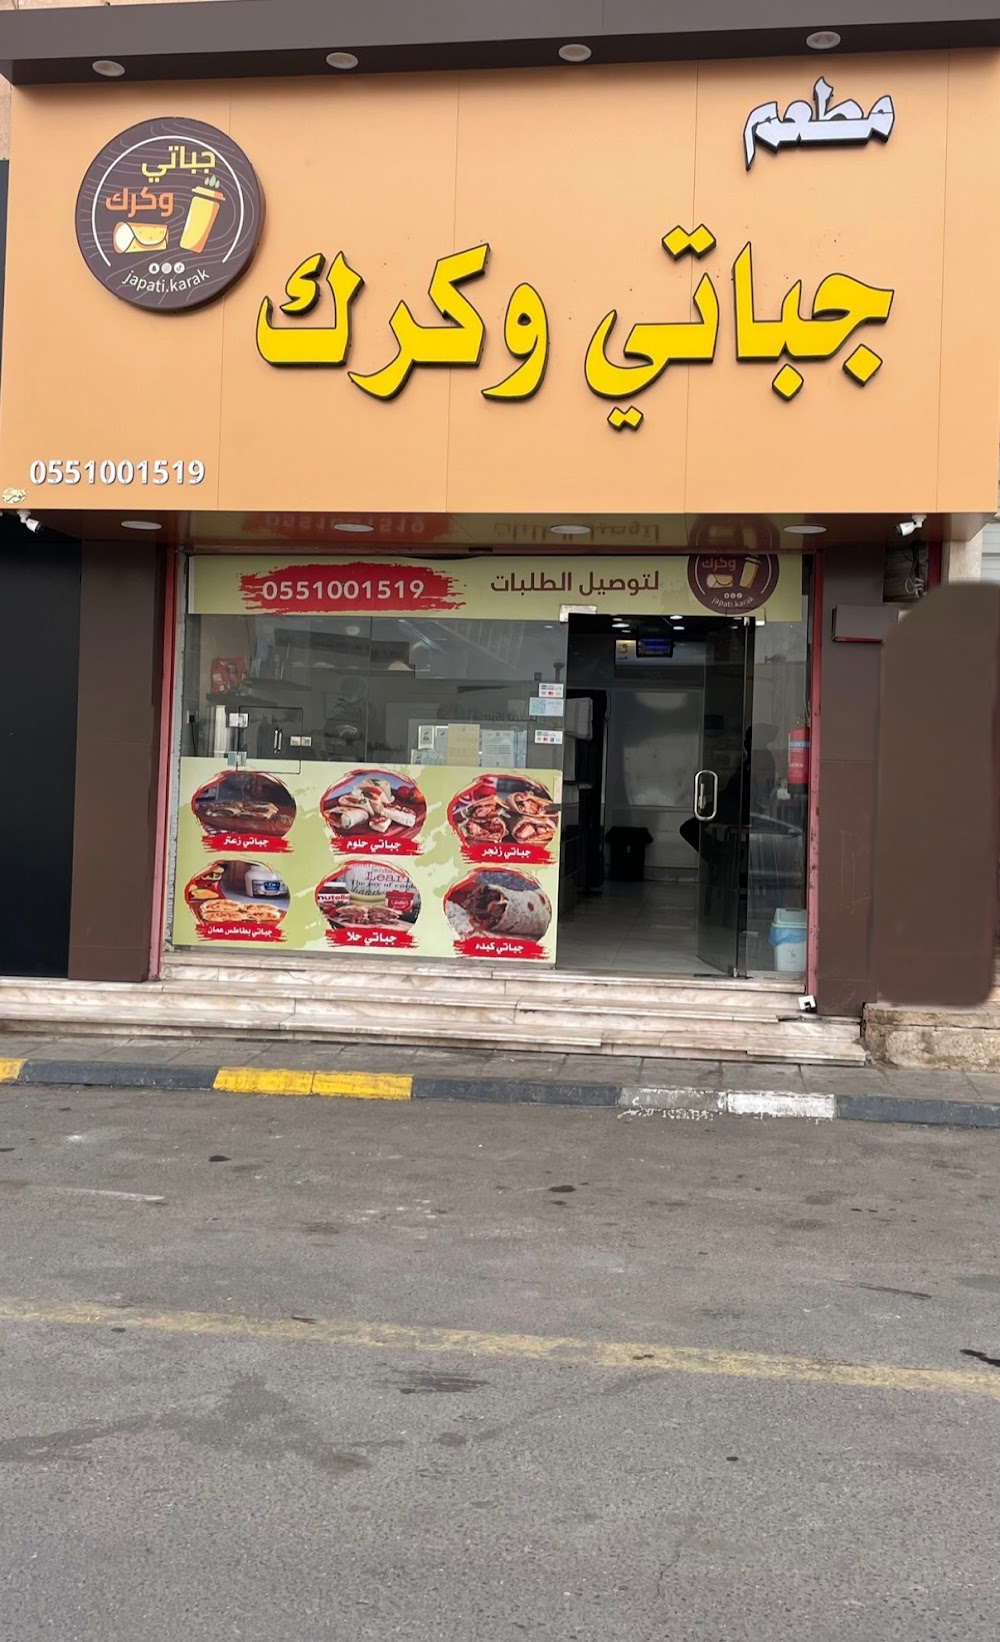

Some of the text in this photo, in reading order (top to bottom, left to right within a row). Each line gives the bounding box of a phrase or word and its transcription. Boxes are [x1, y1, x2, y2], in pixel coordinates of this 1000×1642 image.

[743, 76, 895, 171] مطعم
[141, 145, 217, 183] جباتي
[105, 186, 174, 218] وكرك
[122, 268, 210, 293] japati.karak
[255, 224, 895, 431] جباتي وكرك
[29, 459, 206, 485] 0551001519
[701, 557, 737, 572] وكرك
[261, 580, 425, 600] 0551001519
[490, 570, 660, 596] لتوصيل الطلبات
[711, 596, 755, 608] japati.karak
[223, 835, 269, 848] جباتي زعتر
[346, 839, 401, 853] جباتي حلوم
[481, 846, 531, 859] جباتي زنجر
[251, 927, 273, 938] جباتي
[346, 931, 397, 945] جباتي حلا
[474, 941, 524, 955] جباتي كبده
